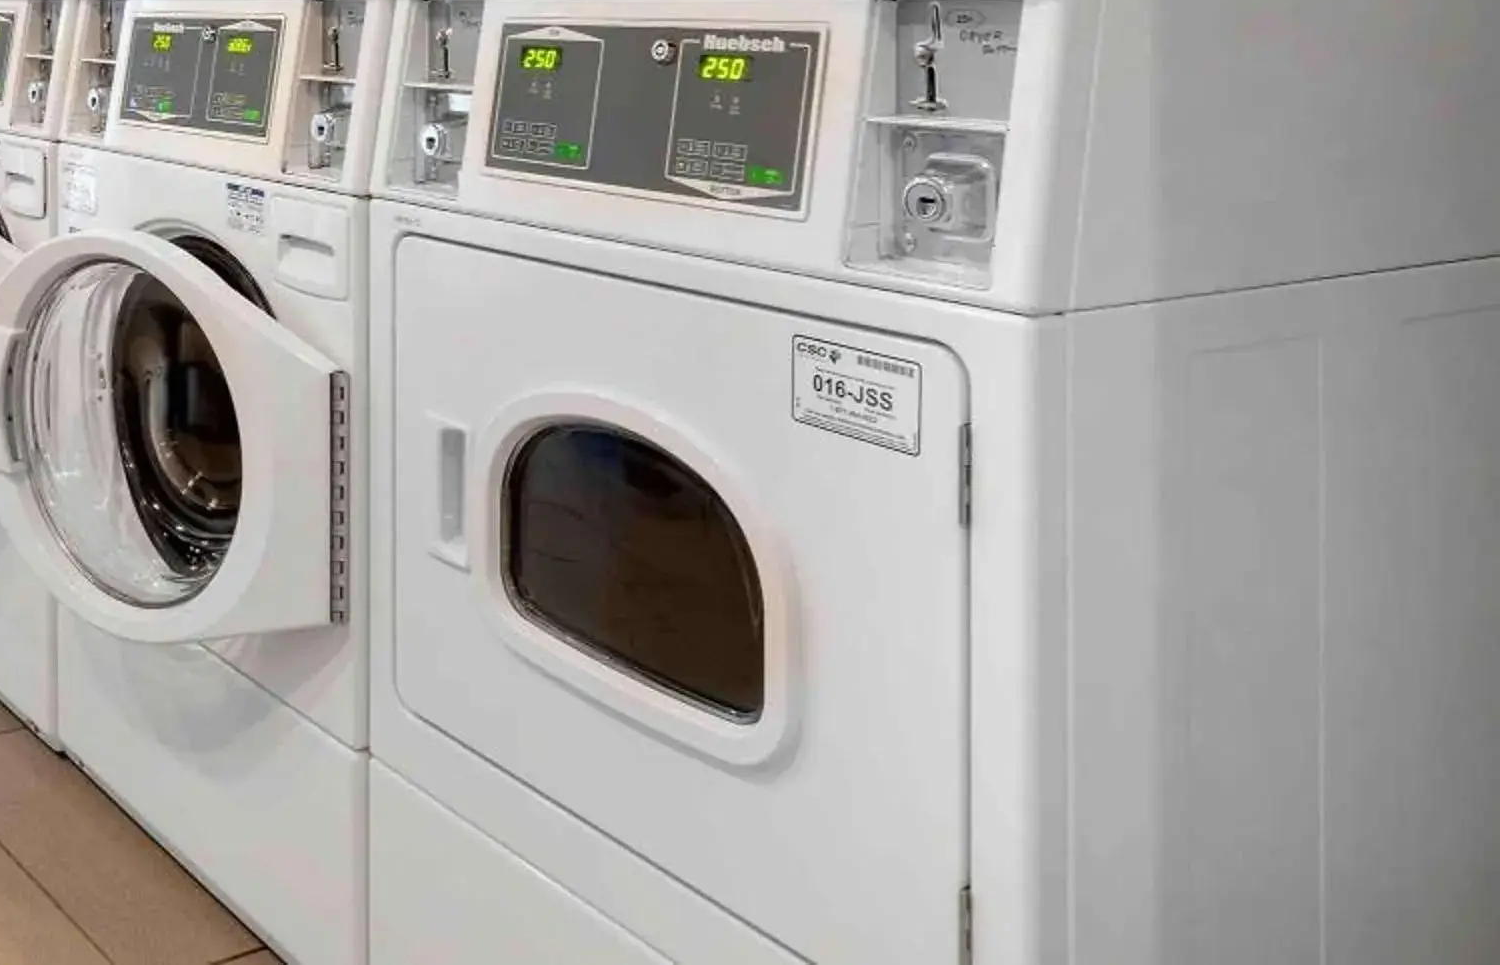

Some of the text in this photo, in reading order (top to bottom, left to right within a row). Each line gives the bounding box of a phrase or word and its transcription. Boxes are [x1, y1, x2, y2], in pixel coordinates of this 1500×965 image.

[703, 34, 785, 52] Huebsch
[523, 48, 557, 69] 250
[702, 56, 745, 80] 250
[813, 374, 893, 412] 016-JSS
